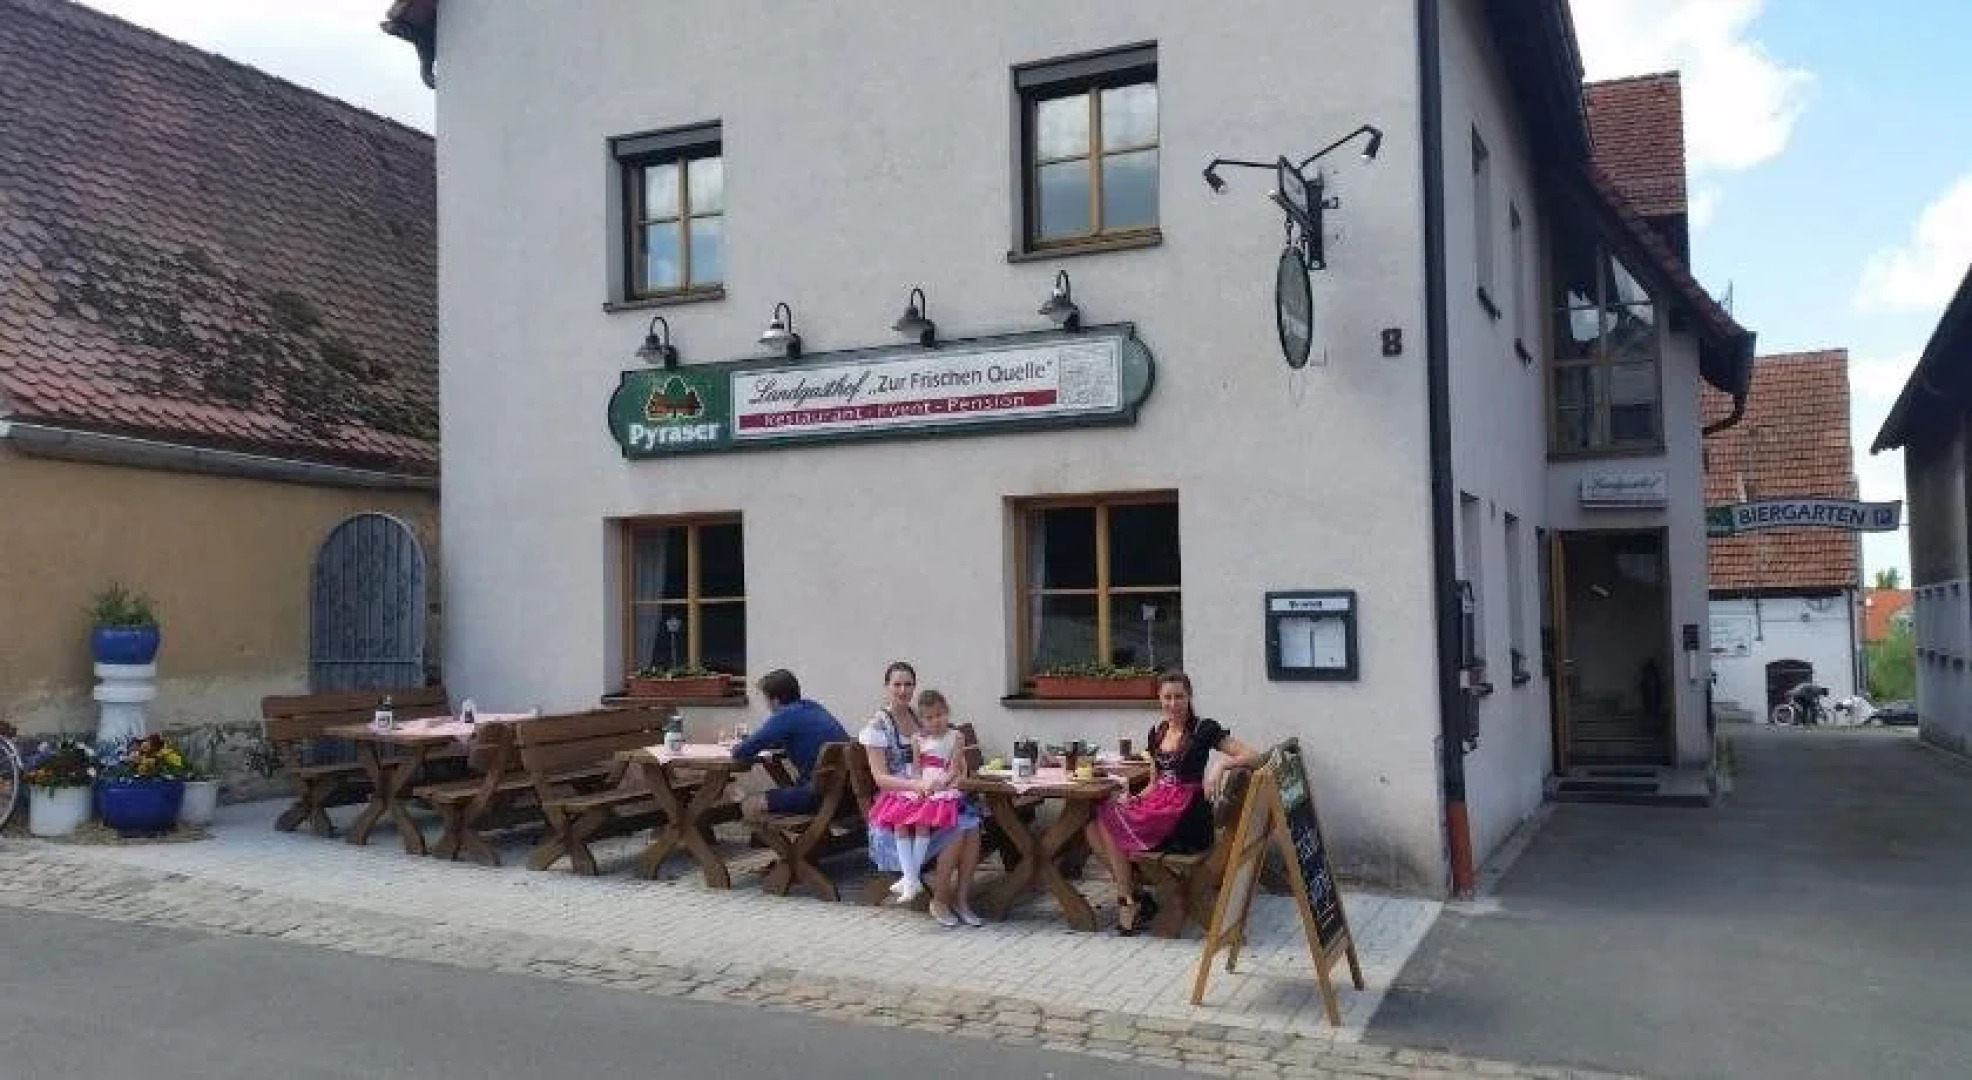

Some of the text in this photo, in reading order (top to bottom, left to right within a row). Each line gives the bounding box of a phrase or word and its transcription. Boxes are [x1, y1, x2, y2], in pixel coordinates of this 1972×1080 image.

[1381, 328, 1402, 357] 8
[910, 365, 983, 388] Frischen
[763, 407, 862, 427] Restaurant
[877, 403, 930, 418] Event
[947, 394, 1025, 412] Pension
[628, 423, 720, 449] Pyraser
[1739, 504, 1865, 525] BIERGARTEN
